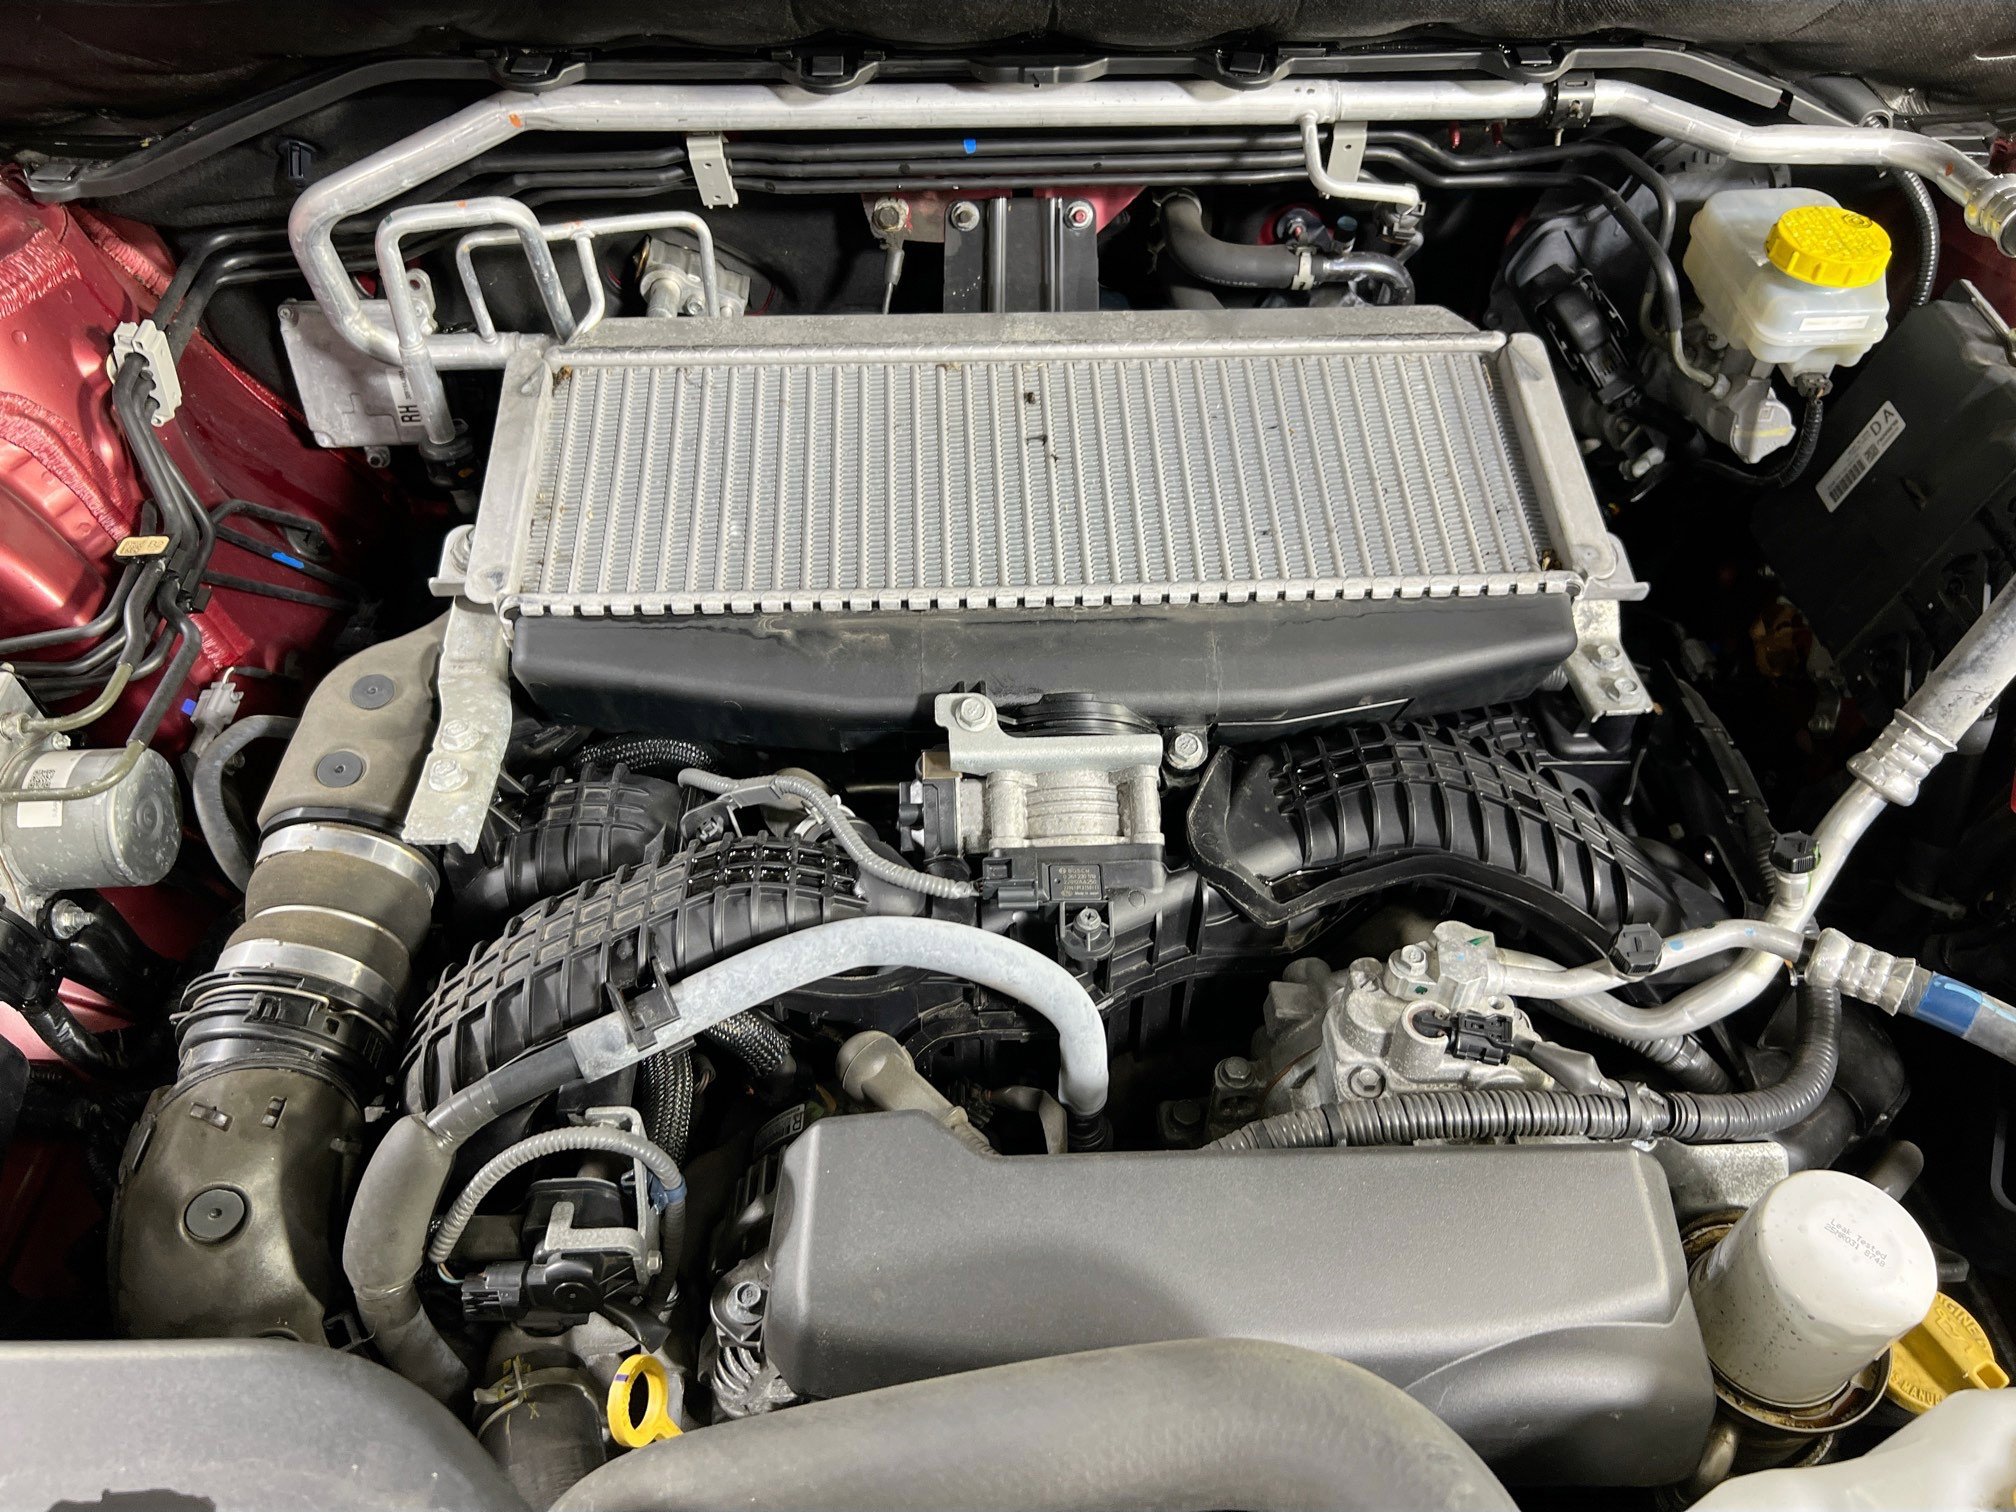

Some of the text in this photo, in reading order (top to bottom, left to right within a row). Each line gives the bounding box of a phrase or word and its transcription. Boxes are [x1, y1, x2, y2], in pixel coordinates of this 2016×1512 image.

[398, 405, 421, 422] RH
[1830, 1218, 1888, 1260] Leak Tested
